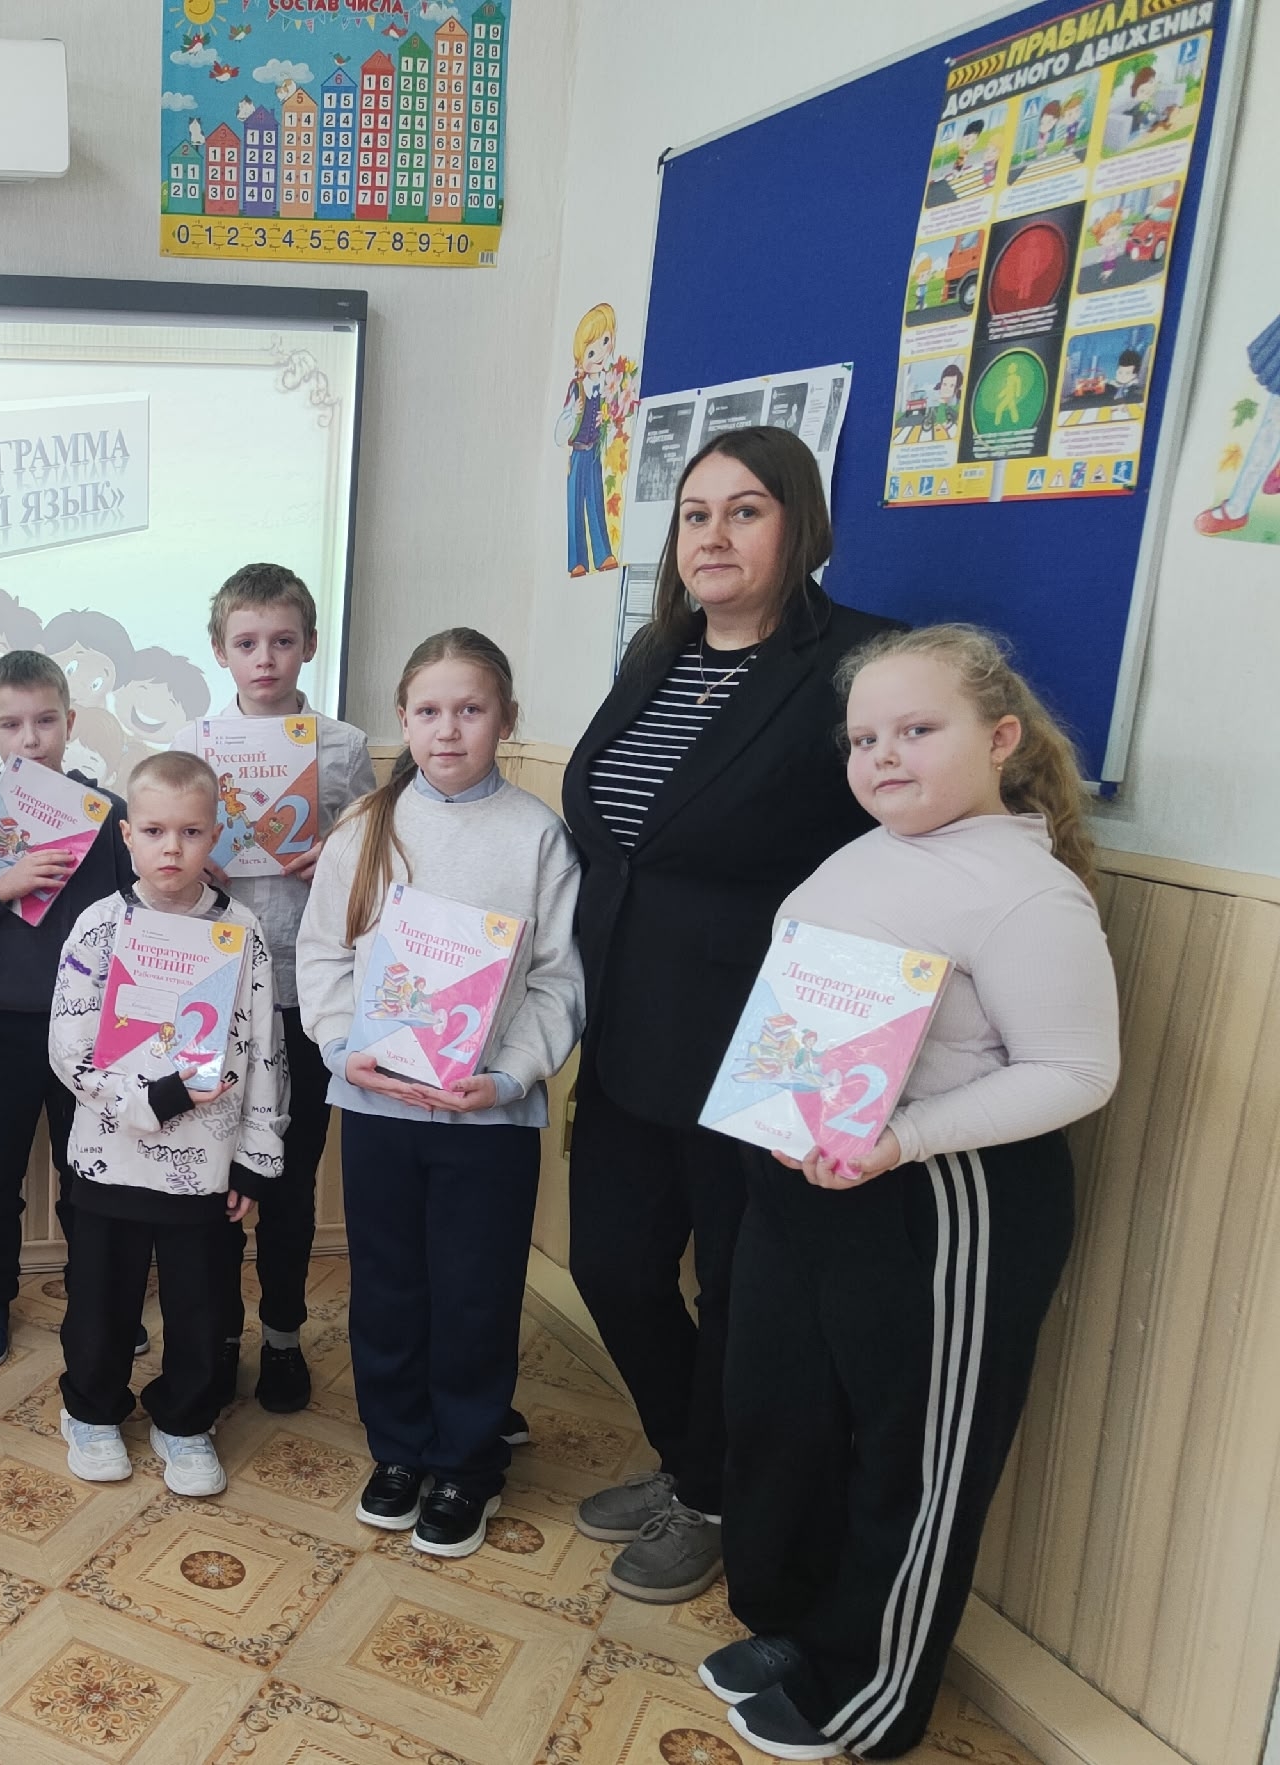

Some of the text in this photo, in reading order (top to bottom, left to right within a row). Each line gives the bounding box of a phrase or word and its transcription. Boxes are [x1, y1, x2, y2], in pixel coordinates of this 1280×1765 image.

[269, 0, 404, 14] СОСТАВ ЧИСЛА
[448, 21, 456, 33] 9
[1006, 0, 1138, 68] ПРАВИЛА
[941, 2, 1214, 120] ДОРОЖНОГО ДВИЖЕНИЯ
[334, 74, 343, 85] 6
[296, 92, 304, 104] 5
[181, 145, 189, 156] 2
[177, 224, 469, 253] 0 1 2 3 4 5 6 7 8 9 10
[20, 480, 125, 524] ЯЗЫК»
[204, 747, 267, 766] Русский
[238, 764, 288, 779] ЯЗЫК
[10, 785, 78, 825] Литературное
[18, 801, 65, 830] ЧТЕНИЕ
[274, 794, 314, 855] 2
[125, 938, 210, 963] Литературное
[395, 920, 482, 957] Литературное
[137, 955, 195, 975] ЧТЕНИЕ
[405, 939, 465, 968] ЧТЕНИЕ
[783, 961, 895, 1005] Литературное
[795, 985, 872, 1018] ЧТЕНИЕ
[174, 1001, 219, 1065] 2
[438, 1004, 481, 1065] 2
[824, 1064, 888, 1138] 2
[784, 1130, 792, 1140] 2
